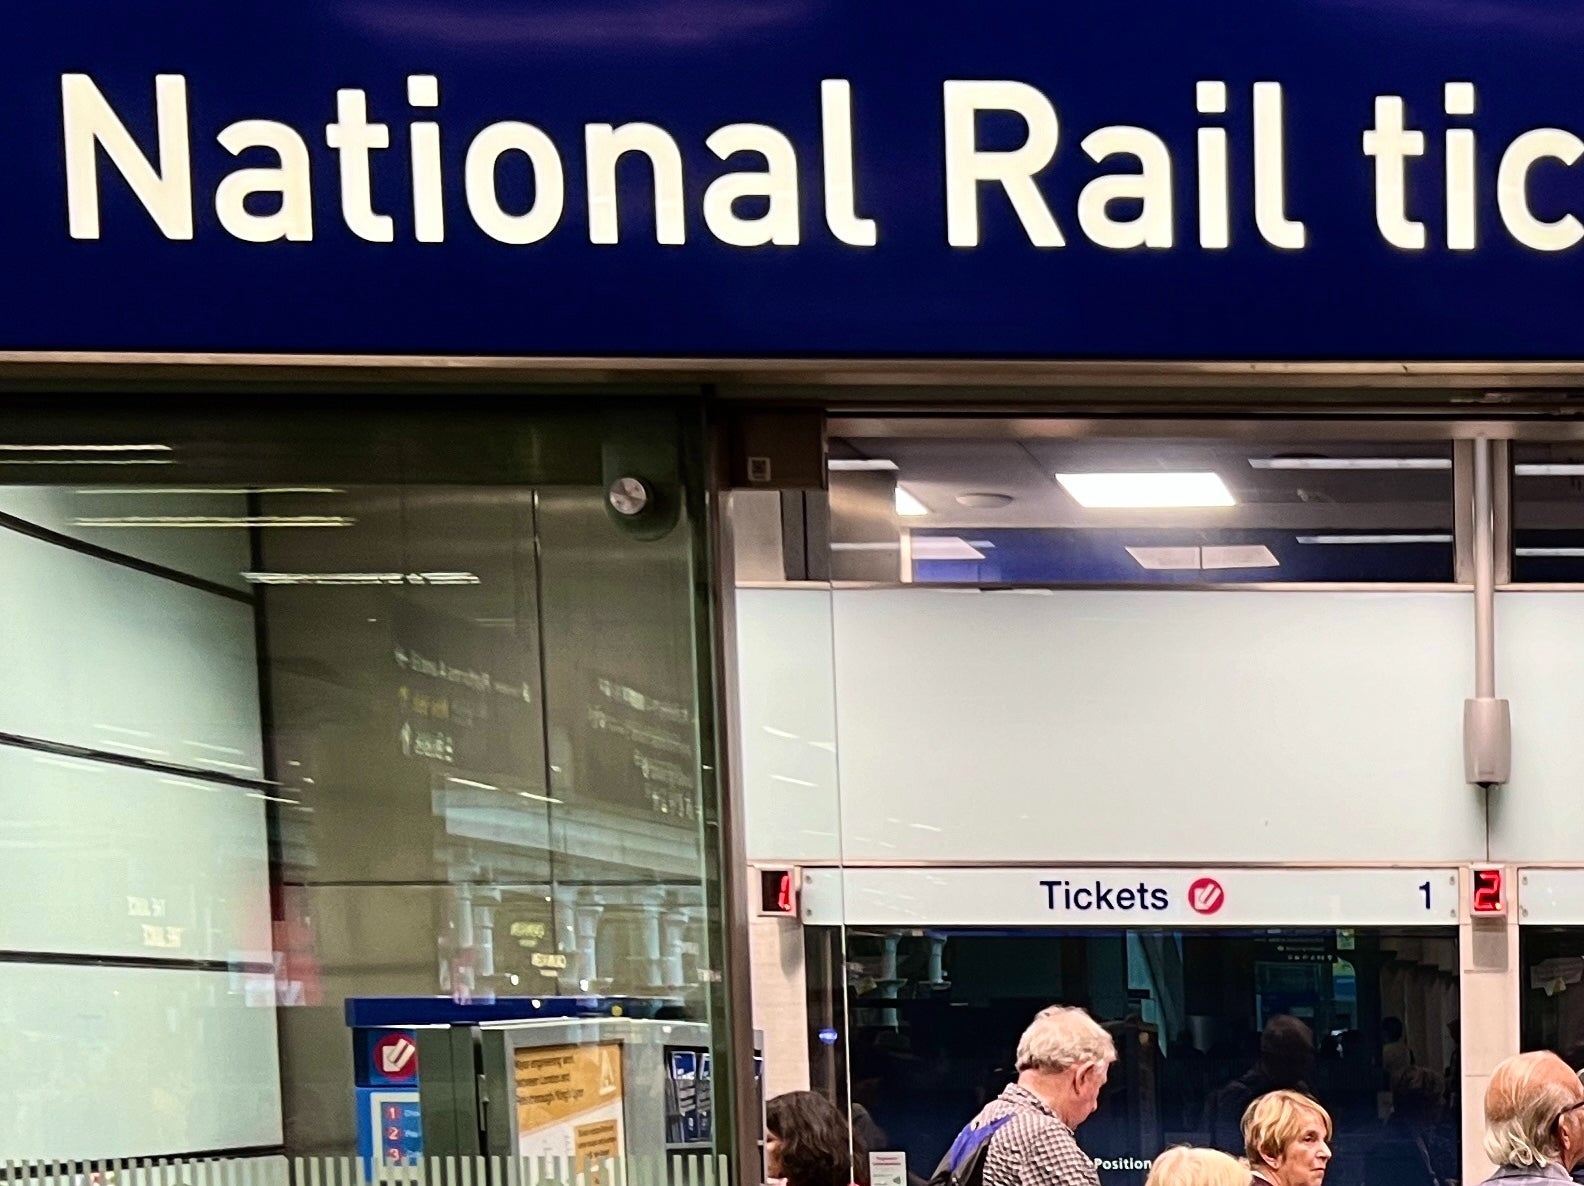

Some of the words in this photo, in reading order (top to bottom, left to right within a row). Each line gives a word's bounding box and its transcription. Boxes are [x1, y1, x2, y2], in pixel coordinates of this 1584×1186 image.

[61, 73, 877, 247] National
[943, 79, 1306, 249] Rail
[1039, 880, 1169, 911] Tickets
[1418, 881, 1431, 910] 1
[388, 1127, 399, 1140] 2
[1093, 1157, 1152, 1170] Position
